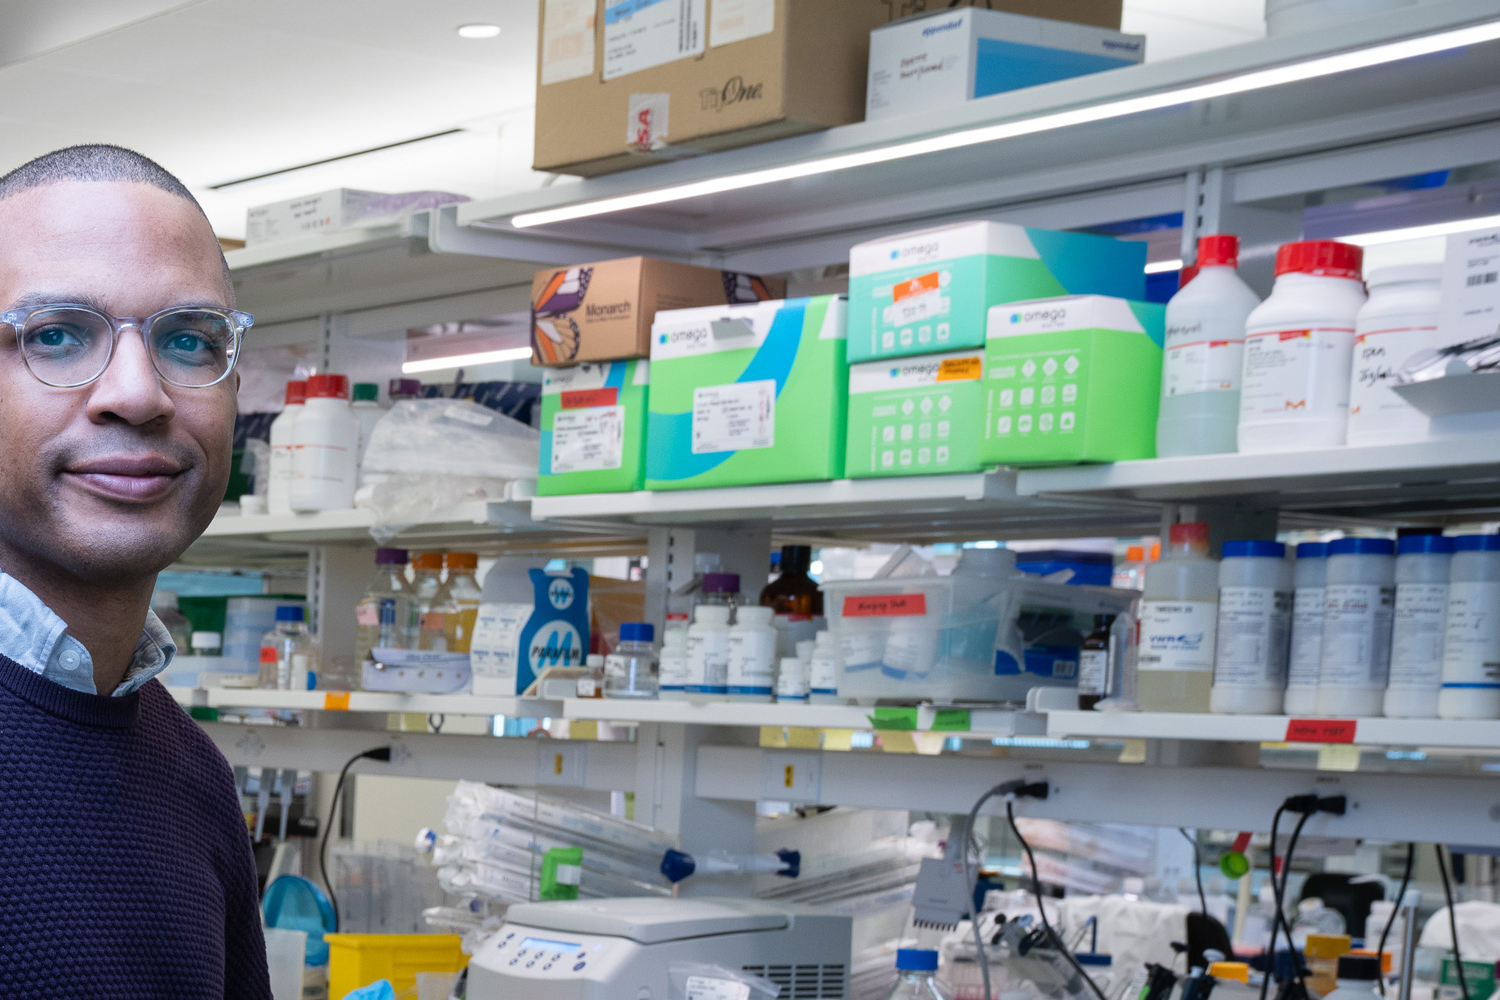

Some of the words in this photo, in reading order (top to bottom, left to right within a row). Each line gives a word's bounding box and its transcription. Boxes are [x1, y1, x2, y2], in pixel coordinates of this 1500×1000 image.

[922, 18, 963, 37] eppendorf
[902, 242, 939, 257] omega
[585, 301, 632, 316] Monarch
[1024, 308, 1066, 322] omega
[671, 328, 707, 343] omega
[902, 359, 939, 375] omega
